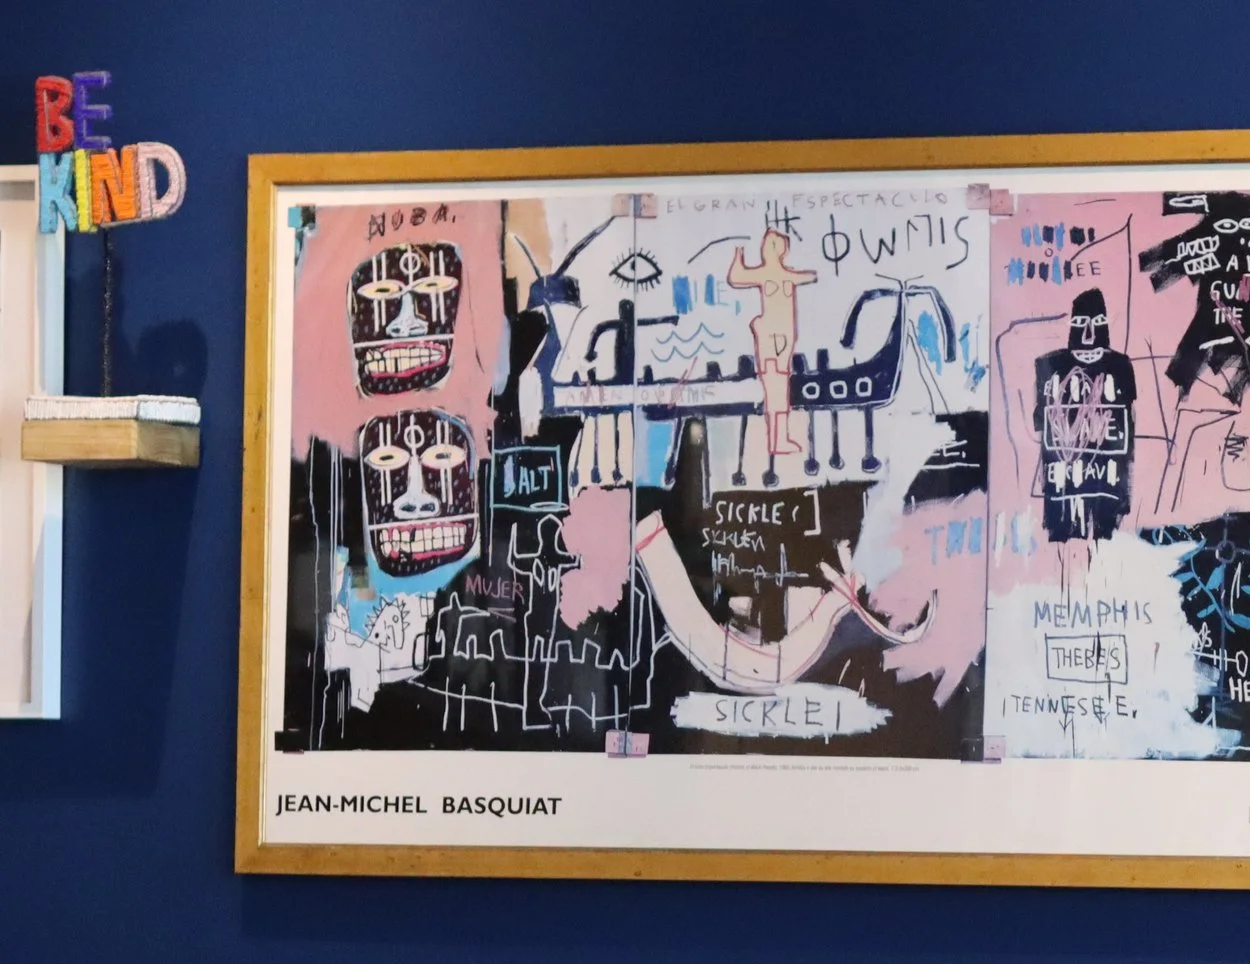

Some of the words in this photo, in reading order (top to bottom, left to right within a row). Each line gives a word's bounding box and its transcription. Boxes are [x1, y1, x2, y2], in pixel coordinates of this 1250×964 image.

[35, 70, 111, 152] BE
[38, 141, 187, 233] KIND
[1225, 254, 1239, 273] A
[715, 500, 786, 526] SICKLE
[465, 574, 525, 605] MUJER
[1033, 597, 1153, 629] MEMPHIS
[1051, 646, 1121, 671] THEBES
[715, 696, 824, 727] SICKLE
[275, 794, 428, 816] JEAN-MICHEL
[441, 796, 563, 818] BASQUIAT
